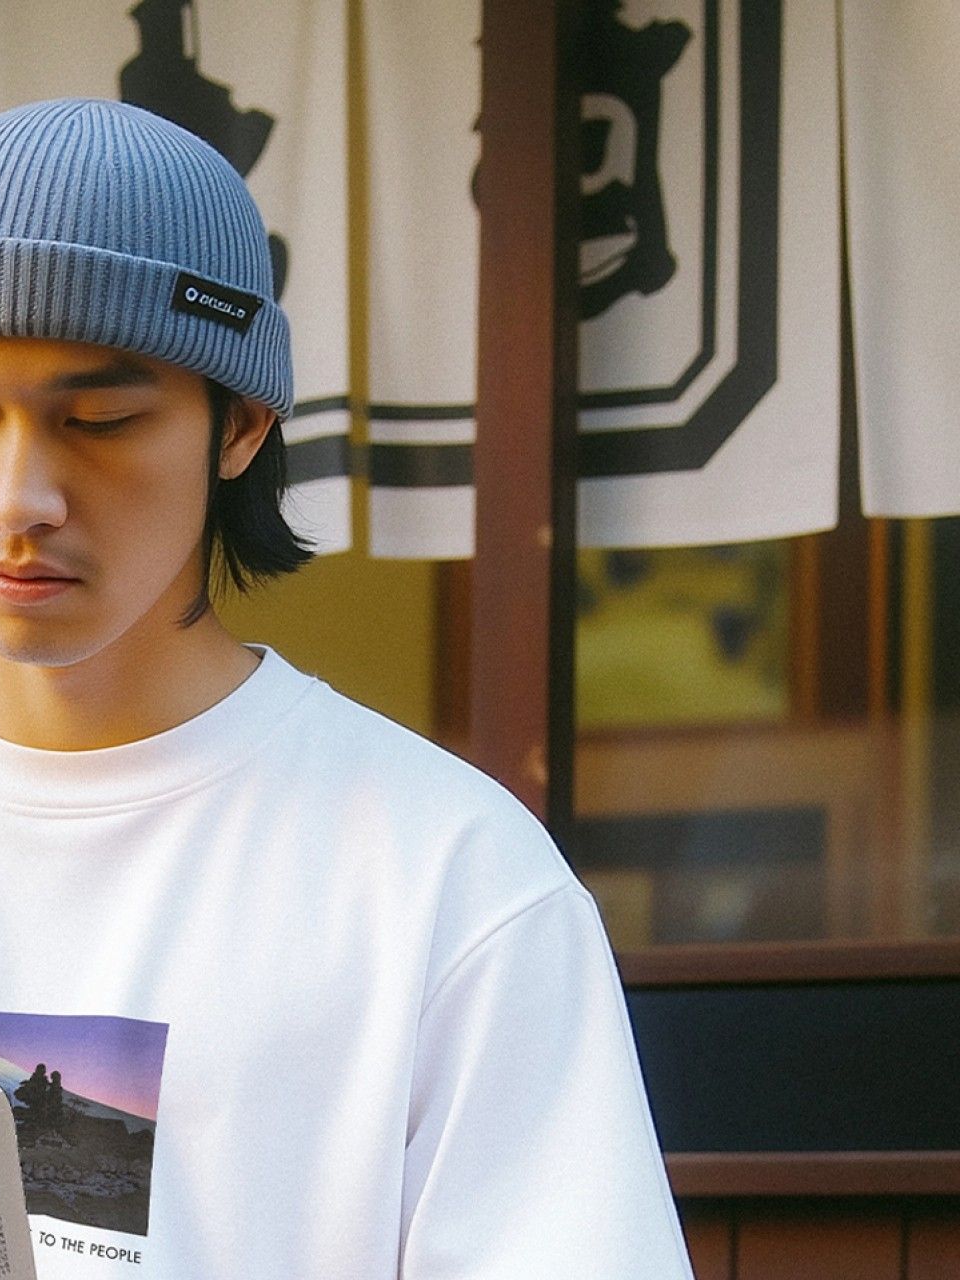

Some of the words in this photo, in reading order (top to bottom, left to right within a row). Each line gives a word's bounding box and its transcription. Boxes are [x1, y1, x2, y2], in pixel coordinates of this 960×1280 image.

[39, 1231, 56, 1247] TO
[61, 1237, 85, 1254] THE
[90, 1243, 141, 1264] PEOPLE
